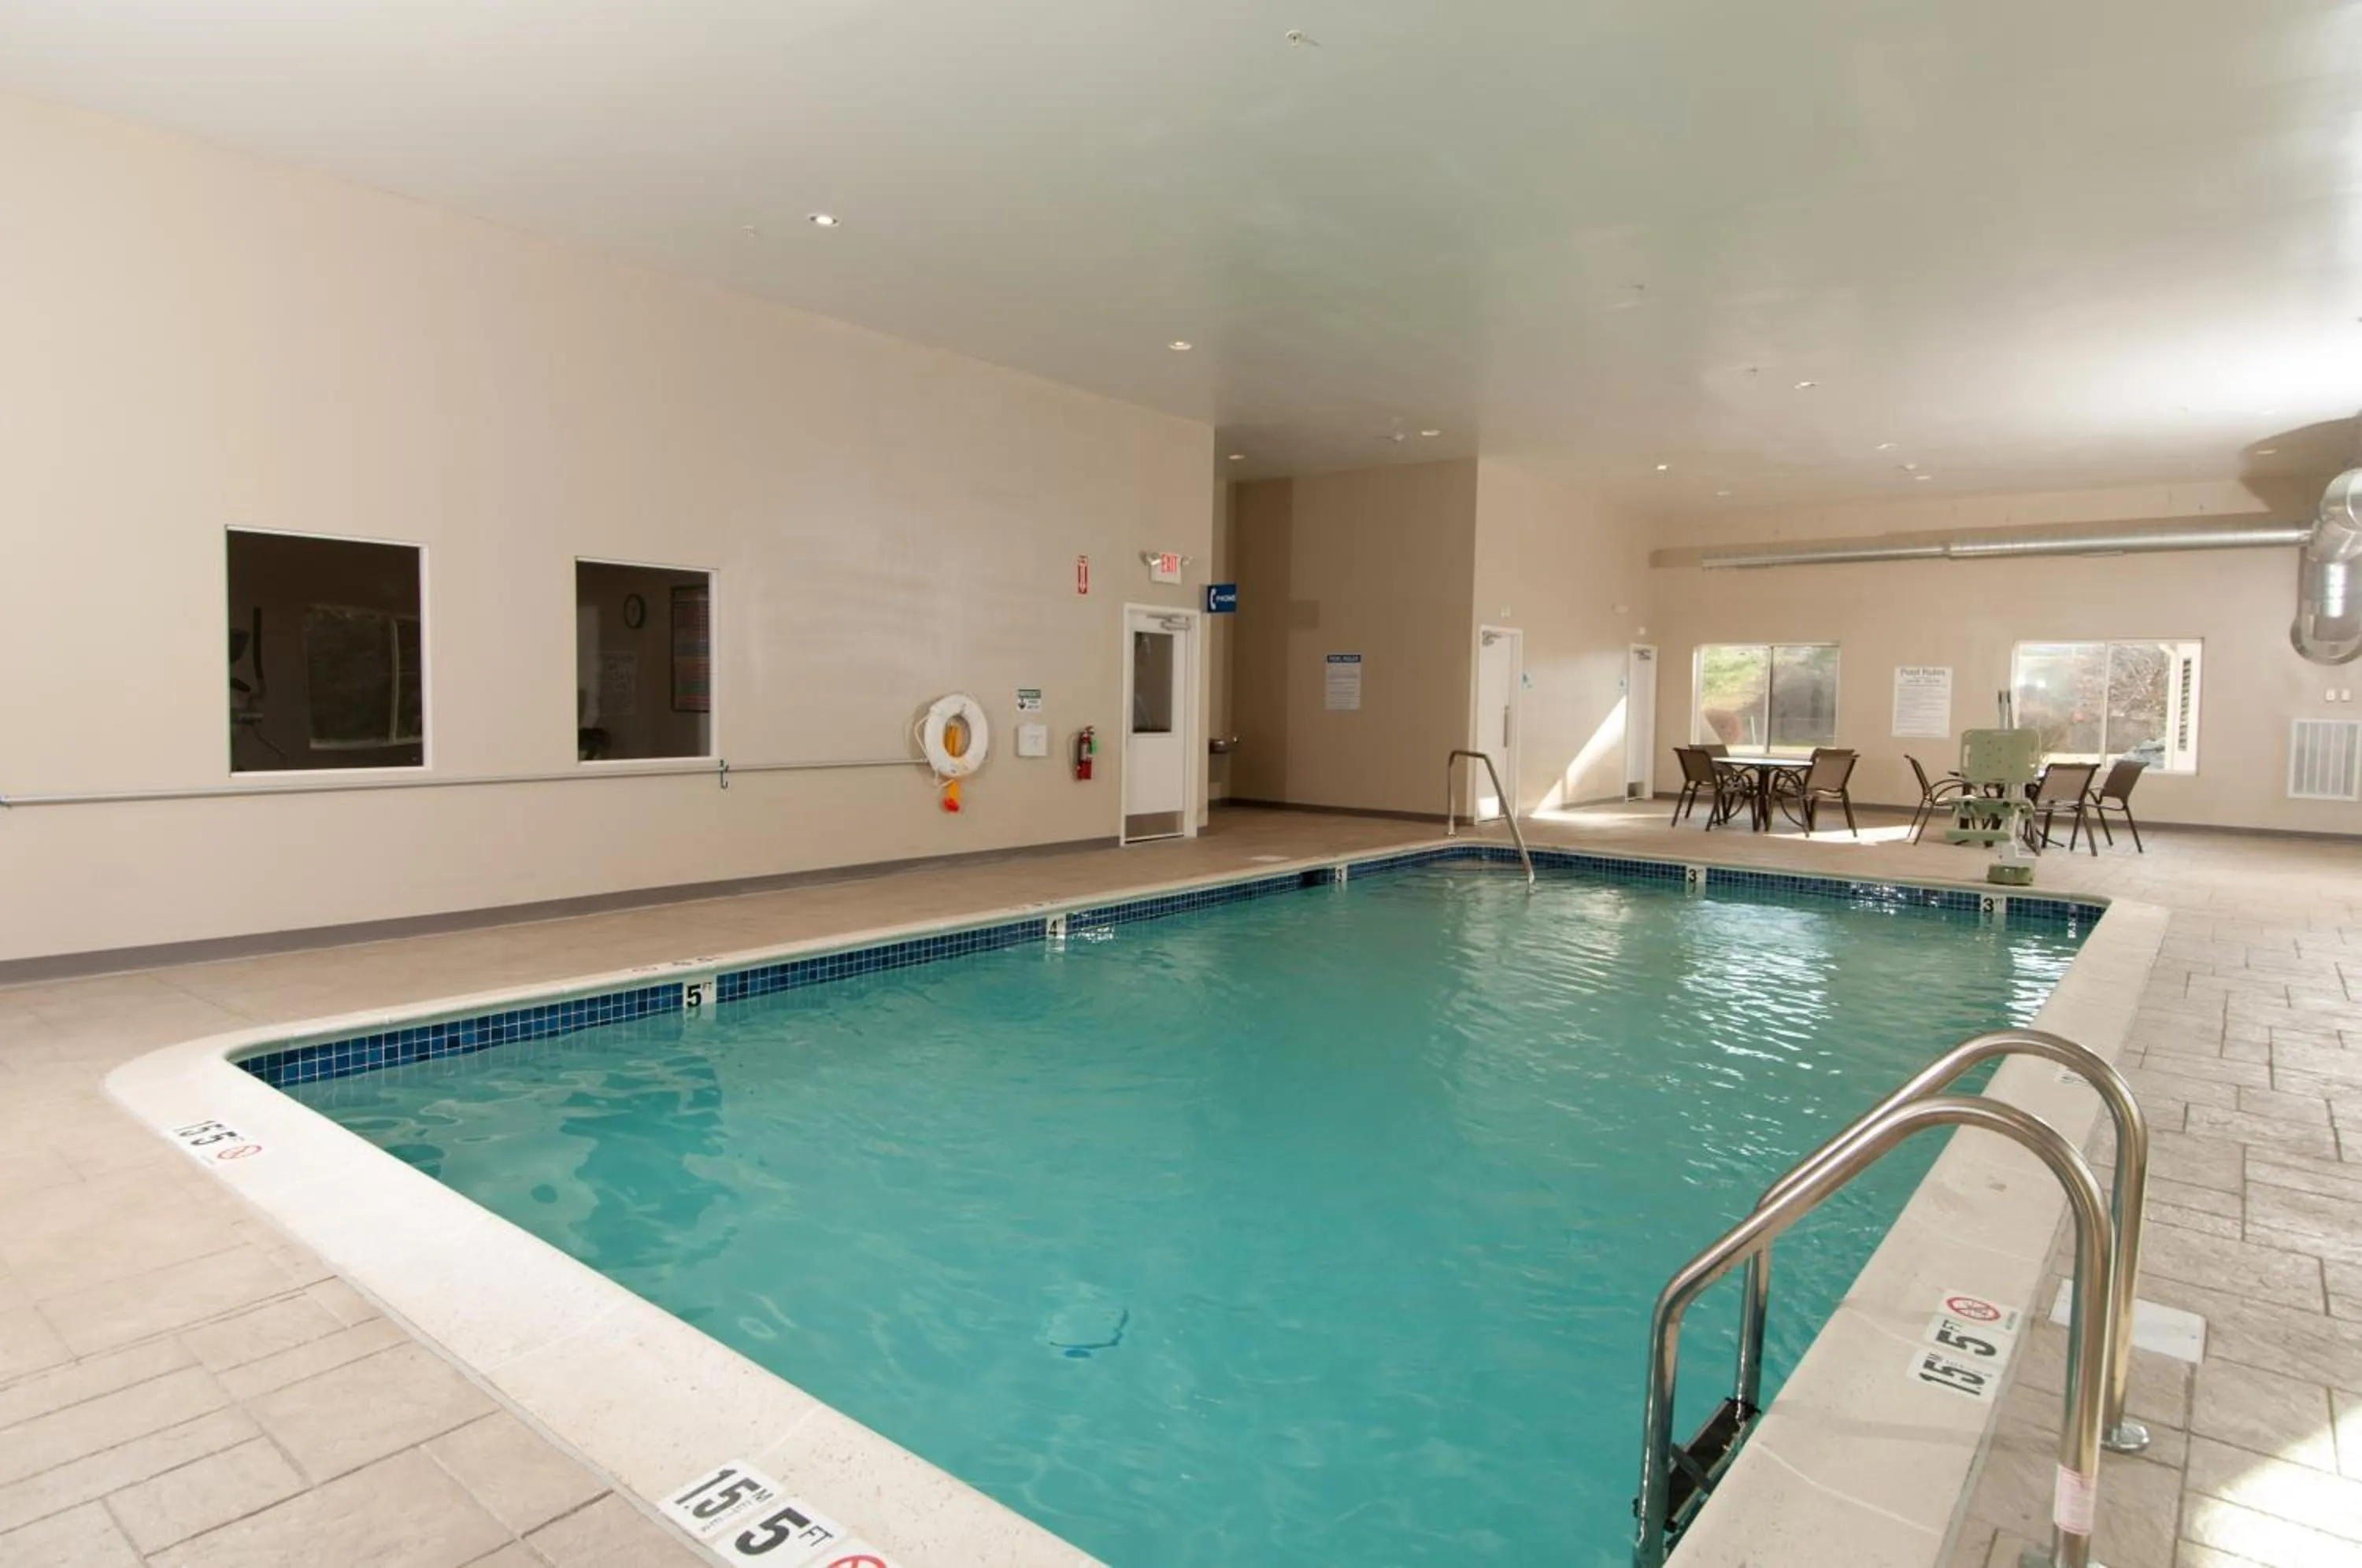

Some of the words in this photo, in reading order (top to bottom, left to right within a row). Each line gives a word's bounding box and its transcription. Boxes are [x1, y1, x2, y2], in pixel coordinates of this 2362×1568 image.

[1161, 553, 1178, 574] EXIT
[1688, 868, 1697, 882] 3
[1983, 897, 1994, 912] 3
[687, 983, 702, 1008] 5
[191, 1130, 238, 1146] 5
[1935, 1328, 1997, 1357] 5
[735, 1507, 811, 1556] 5
[798, 1525, 835, 1547] FT
